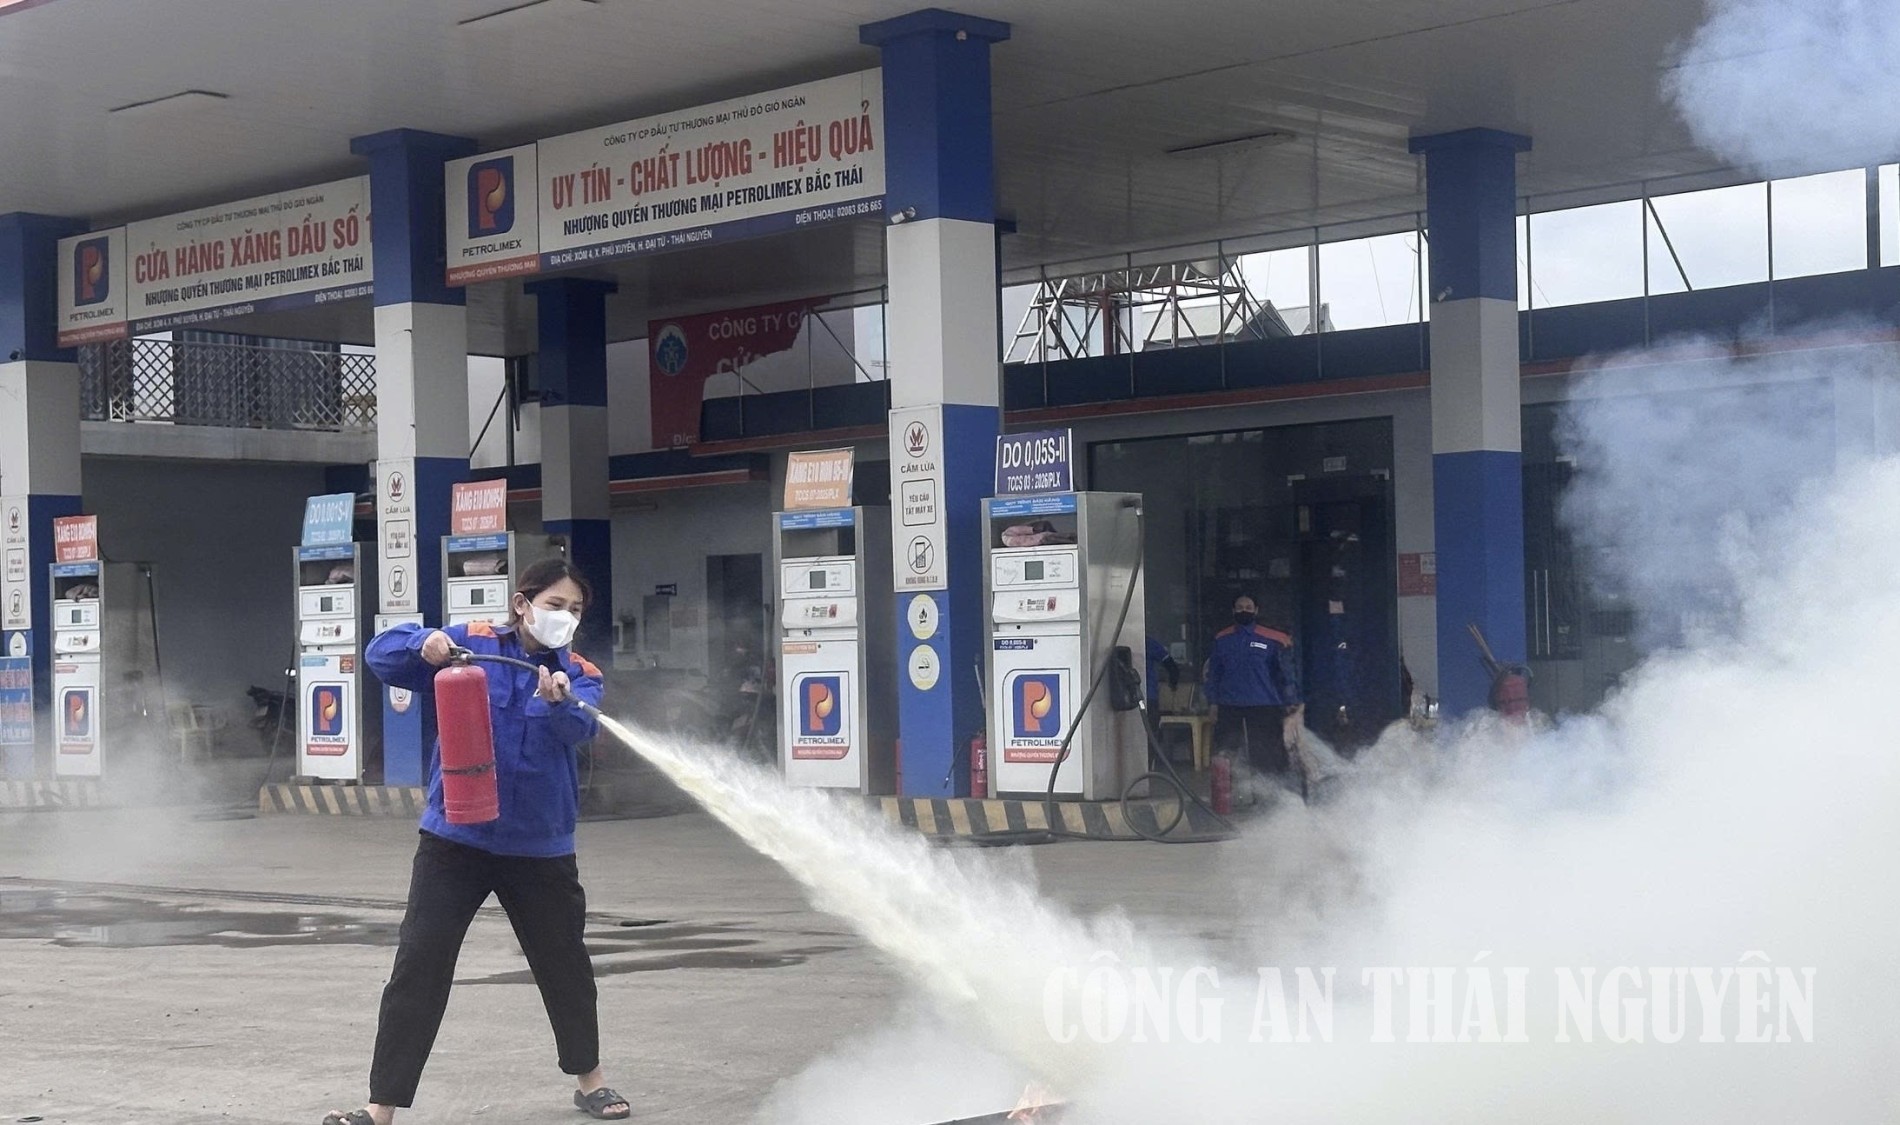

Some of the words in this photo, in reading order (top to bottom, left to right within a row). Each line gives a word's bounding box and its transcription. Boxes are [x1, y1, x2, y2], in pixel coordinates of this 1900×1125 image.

[604, 133, 626, 147] CÔNG
[627, 132, 638, 142] TY
[639, 130, 649, 140] CP
[715, 113, 731, 125] MẠI
[552, 174, 576, 210] UY
[581, 161, 611, 204] TÍN
[630, 142, 680, 195] CHẤT
[686, 138, 752, 187] LƯỢNG
[773, 120, 821, 172] HIỆU
[829, 100, 874, 161] QUẢ
[564, 213, 609, 235] NHƯỢNG
[651, 197, 697, 220] THƯƠNG
[701, 192, 723, 213] MẠI
[726, 177, 802, 206] PETROLIMEX
[806, 168, 831, 193] BẮC
[835, 164, 863, 187] THÁI
[135, 241, 170, 284] CỬA
[175, 238, 224, 277] HÀNG
[230, 228, 281, 267] XĂNG
[333, 203, 359, 249] SỐ
[462, 239, 522, 257] PETROLIMEX
[145, 288, 179, 306] NHƯỢNG
[209, 277, 243, 296] THƯƠNG
[245, 275, 262, 291] MẠI
[264, 264, 319, 286] PETROLIMEX
[322, 255, 340, 276] BẮC
[343, 254, 363, 274] THÁI
[70, 308, 115, 321] PETROLIMEX
[709, 316, 757, 341] CÔNG
[761, 314, 784, 333] TY
[1002, 442, 1022, 468] DO
[1024, 436, 1066, 471] 0,05S-II
[901, 462, 918, 473] CẤM
[920, 462, 935, 472] LỬA
[1008, 474, 1023, 492] TCCS
[798, 737, 846, 745] PETROLIMEX
[1011, 739, 1064, 747] PETROLIMEX
